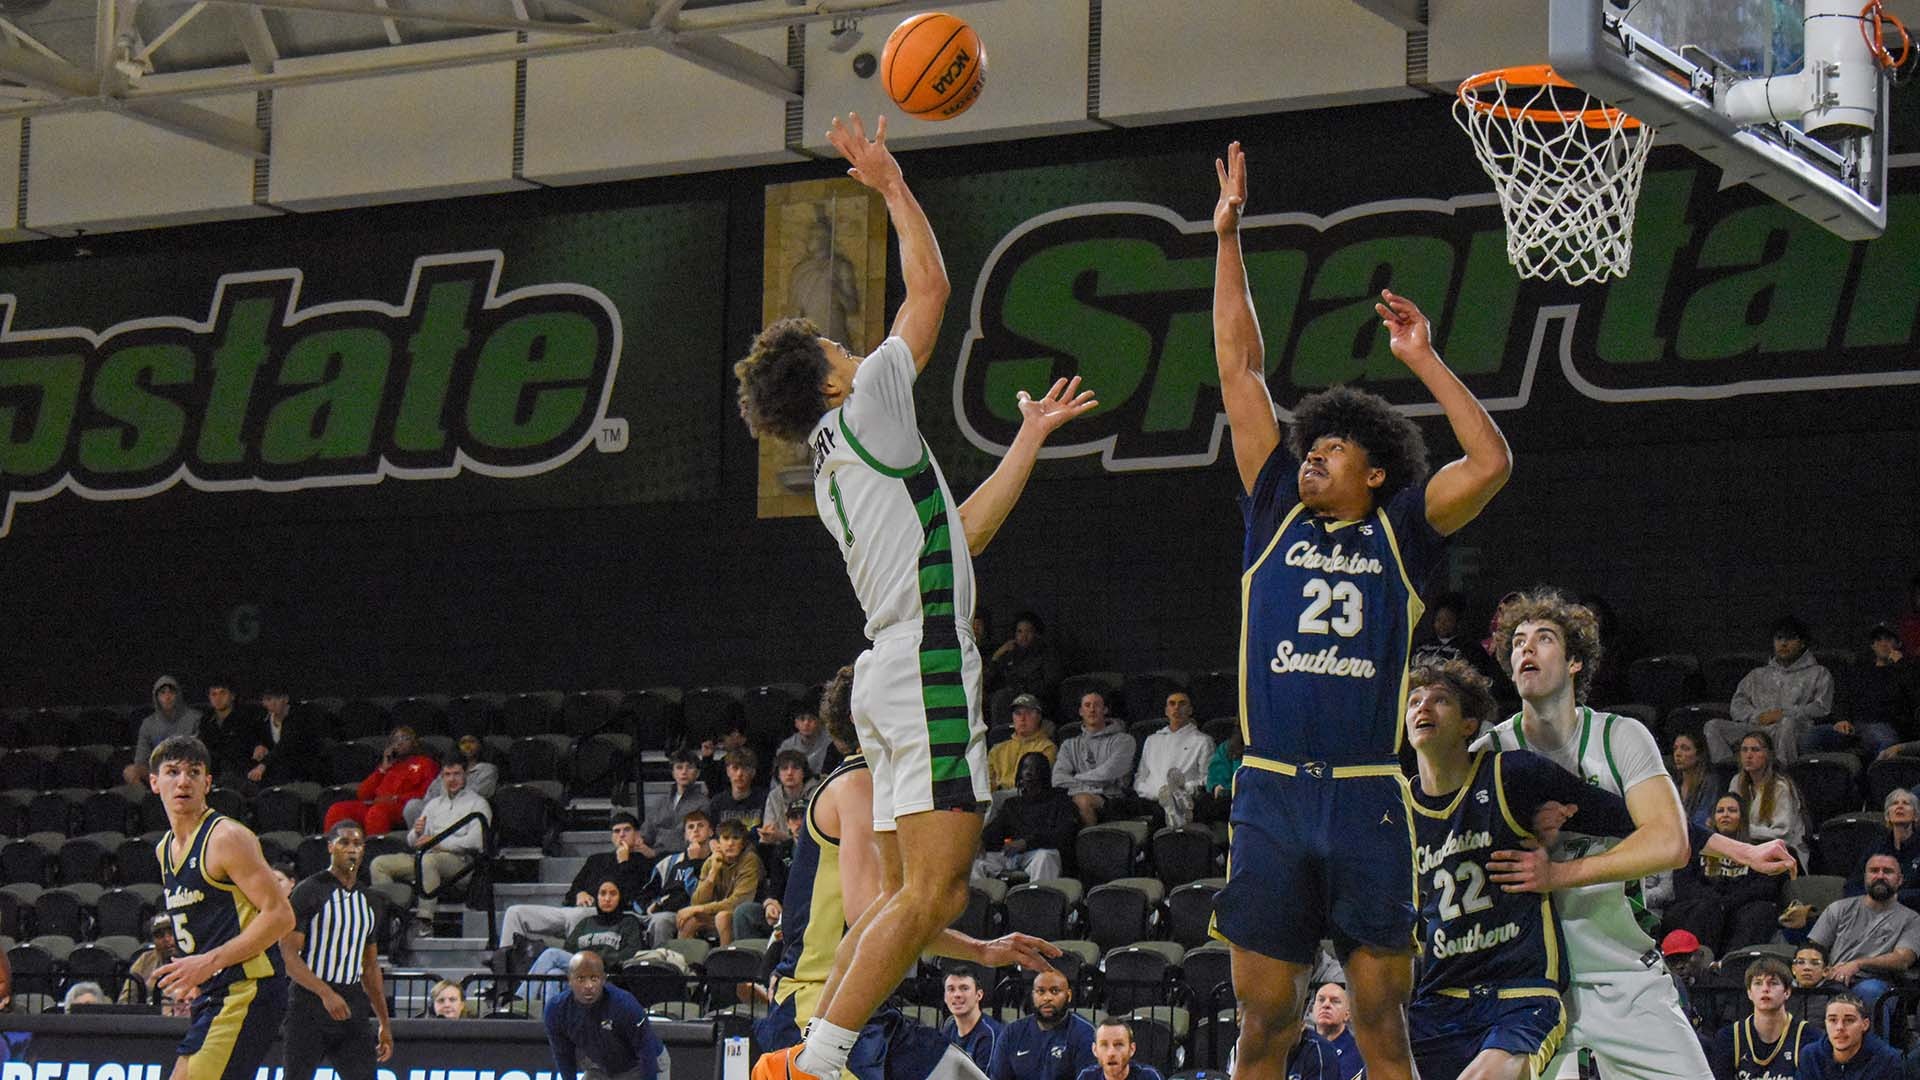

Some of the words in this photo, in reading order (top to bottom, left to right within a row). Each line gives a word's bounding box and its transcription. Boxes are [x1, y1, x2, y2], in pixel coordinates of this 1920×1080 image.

[931, 48, 970, 95] NCAA
[828, 470, 855, 548] 1
[1297, 578, 1363, 637] 23
[1270, 640, 1377, 679] Southern
[1433, 859, 1494, 922] 22
[172, 912, 197, 955] 5
[1433, 922, 1520, 960] Southern
